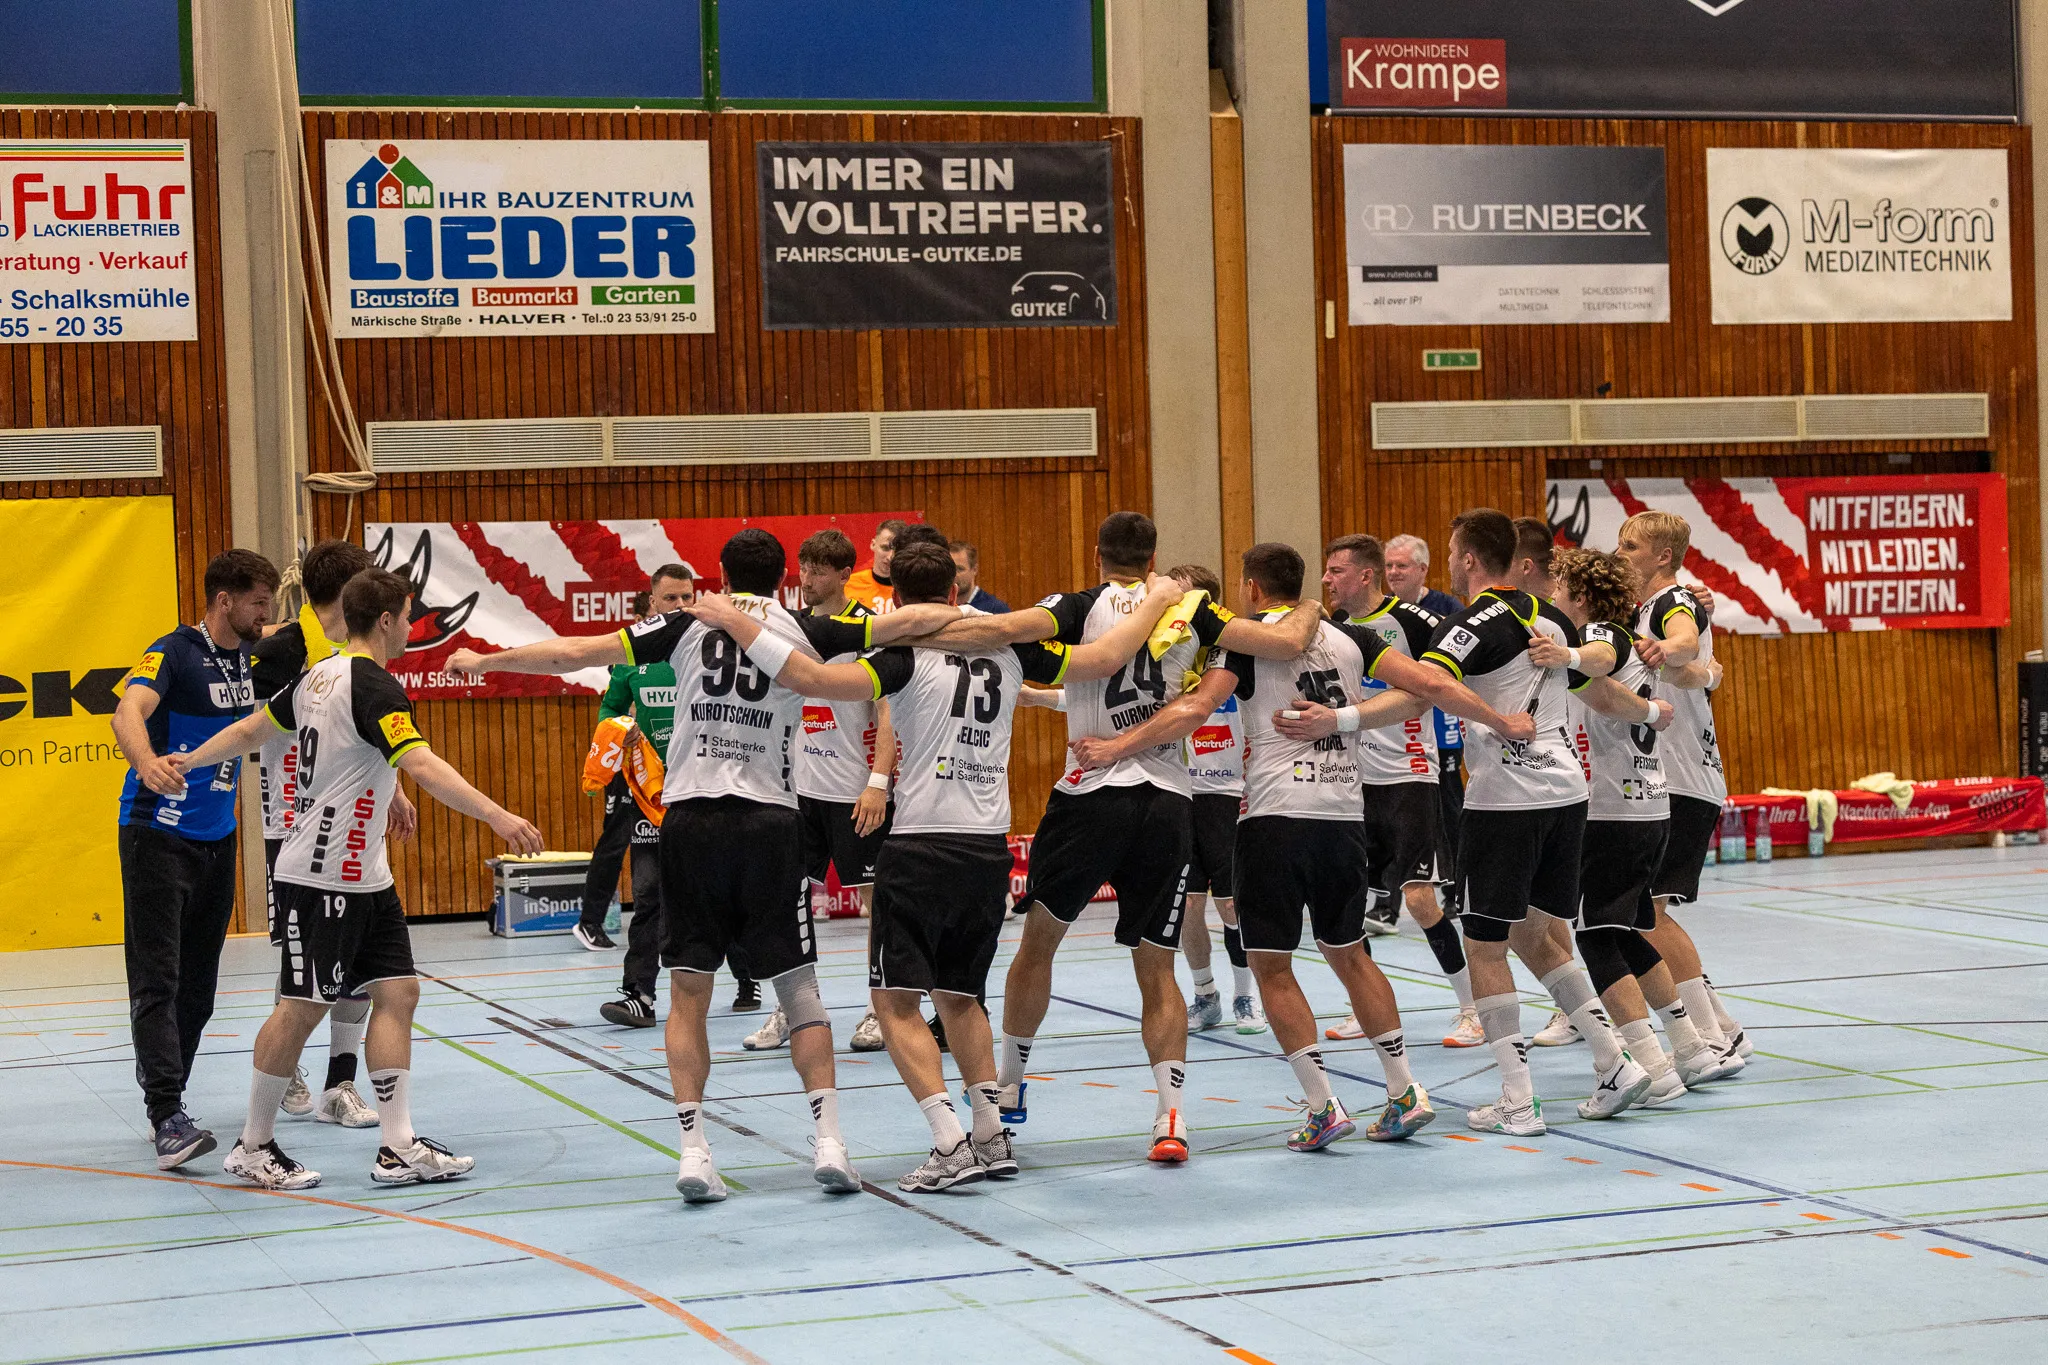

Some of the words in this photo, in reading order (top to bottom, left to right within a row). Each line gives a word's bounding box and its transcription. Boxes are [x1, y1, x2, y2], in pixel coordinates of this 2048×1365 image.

[1375, 44, 1469, 58] WOHNIDEEN
[1347, 48, 1500, 102] Krampe
[773, 157, 924, 191] IMMER
[942, 157, 1015, 191] EIN
[0, 172, 186, 242] fuhr
[440, 191, 486, 208] IHR
[498, 191, 694, 208] BAUZENTRUM
[773, 201, 1103, 235] VOLLTREFFER.
[1433, 204, 1647, 231] RUTENBECK
[34, 222, 180, 238] LACKIERBETRIEB
[346, 214, 696, 281] LIEDER
[776, 246, 1022, 264] FAHRSCHULE-GUTKE.DE
[99, 251, 188, 270] Verkauf
[1805, 250, 1992, 272] MEDIZINTECHNIK
[11, 287, 190, 310] Schalksmühle
[356, 288, 455, 308] Baustoffe
[477, 286, 574, 307] Baumarkt
[605, 285, 681, 304] Garten
[351, 314, 417, 327] Märkische
[420, 314, 462, 327] Straße
[479, 313, 566, 325] HALVER
[1011, 302, 1067, 317] GUTKE
[56, 316, 86, 337] 20
[93, 316, 123, 336] 35
[1809, 493, 1974, 531] MITFIEBERN.
[1820, 537, 1965, 574] MITLEIDEN.
[1824, 578, 1966, 616] MITFEIERN.
[701, 629, 771, 703] 95
[945, 653, 1003, 724] 73
[690, 702, 774, 730] KUROTSCHKIN
[44, 739, 125, 765] Partne
[1195, 738, 1233, 749] bartruff
[1199, 769, 1235, 777] LAKAL
[1769, 805, 1797, 823] Ihre
[323, 895, 347, 918] 19
[523, 896, 584, 918] inSport
